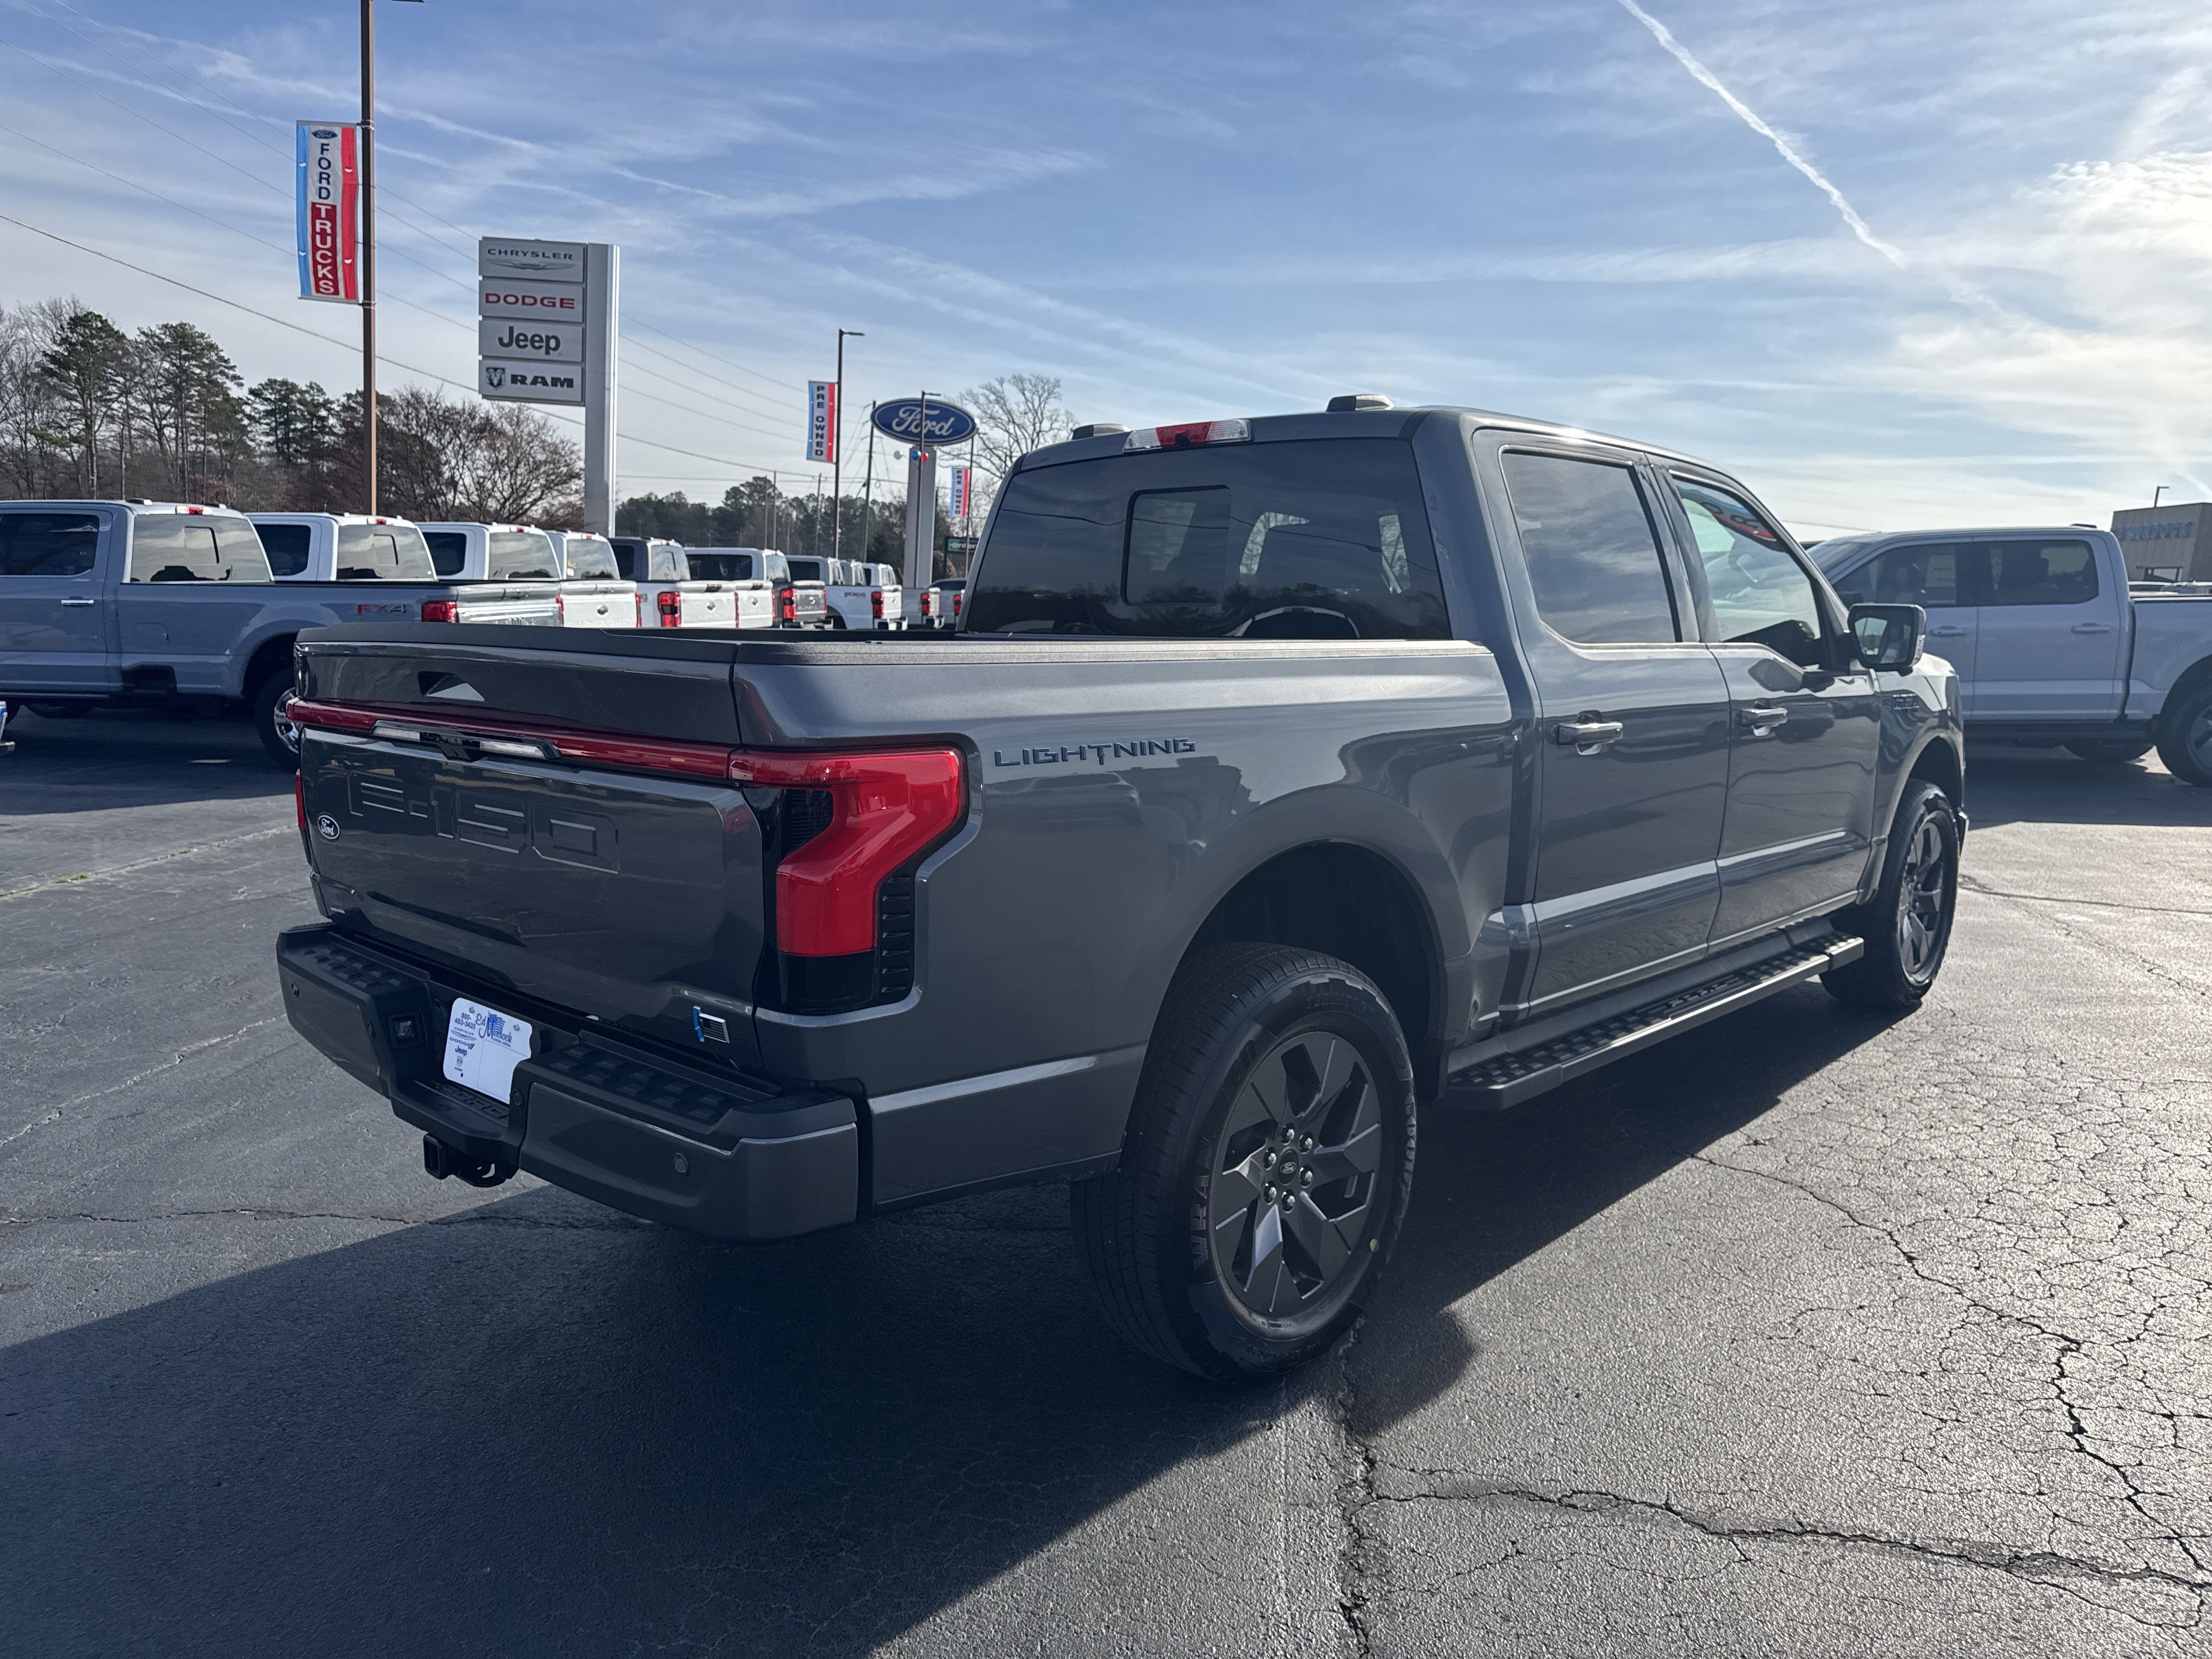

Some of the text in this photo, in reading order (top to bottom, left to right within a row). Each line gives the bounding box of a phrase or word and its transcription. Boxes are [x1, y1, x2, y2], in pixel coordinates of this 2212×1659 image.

[315, 143, 335, 294] FORD TRUCKS
[488, 248, 573, 261] CHRYSLER
[485, 292, 575, 309] DODGE
[498, 326, 561, 356] Jeep
[510, 374, 574, 389] RAM
[815, 386, 825, 456] PRE OWNED
[891, 407, 955, 436] Ford
[357, 603, 407, 614] FX4
[994, 737, 1196, 767] LIGHTNING
[321, 818, 335, 836] Ford
[476, 1013, 486, 1026] Ed
